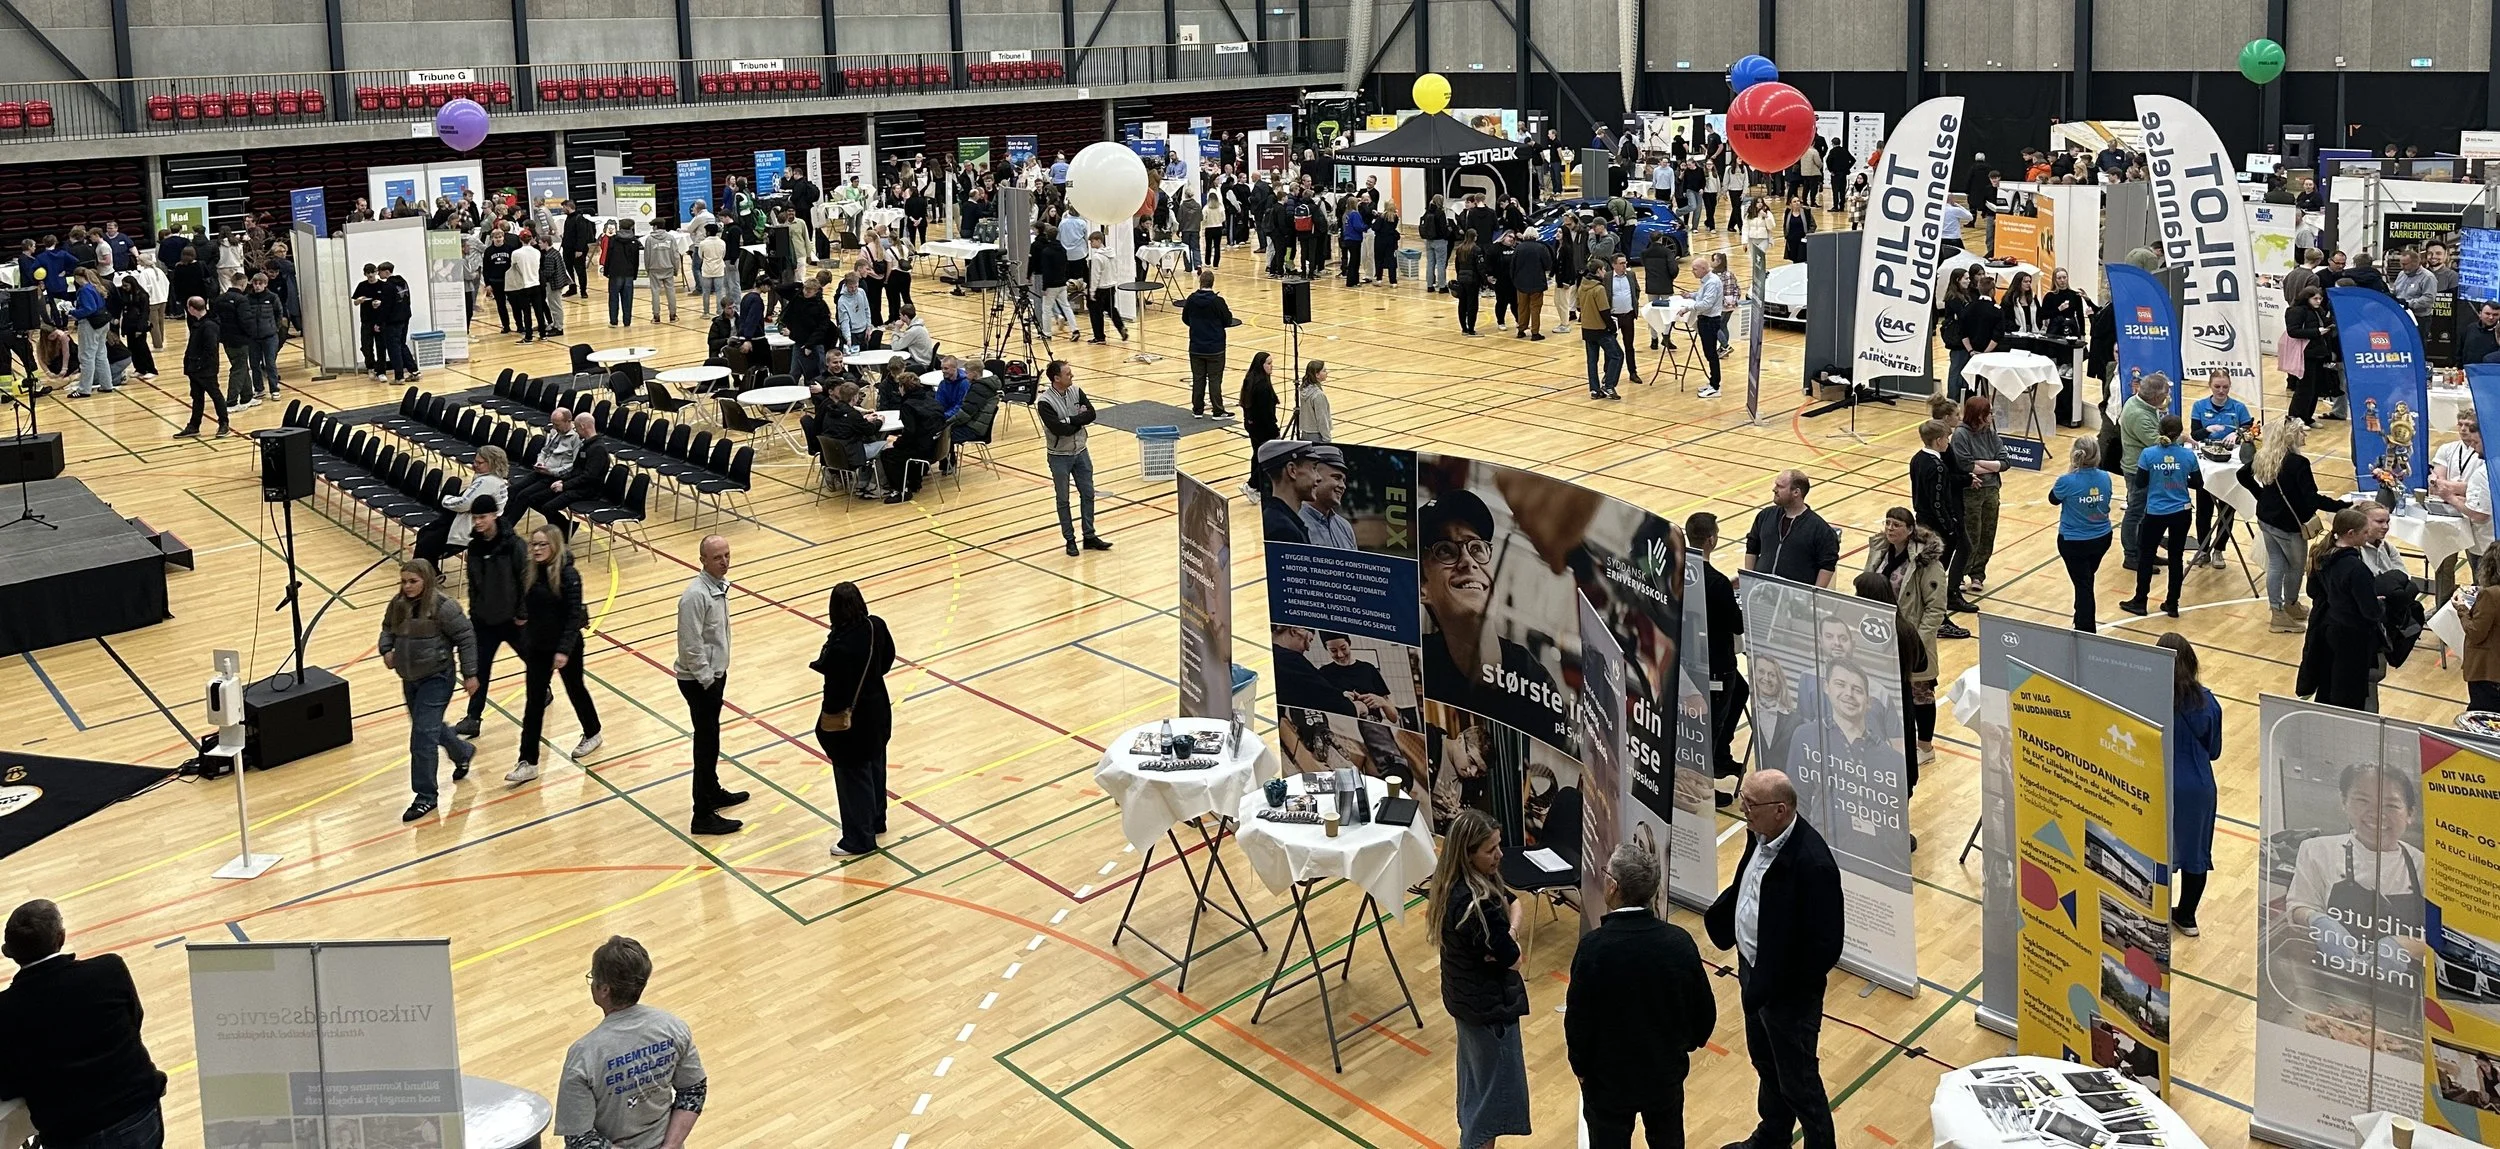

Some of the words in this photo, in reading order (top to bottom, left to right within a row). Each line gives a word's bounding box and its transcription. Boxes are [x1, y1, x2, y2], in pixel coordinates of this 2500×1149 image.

[418, 73, 455, 81] Tribune
[458, 71, 466, 80] G
[739, 62, 769, 70] Tribune
[1335, 154, 1356, 162] MAKE
[1358, 155, 1378, 163] YOUR
[1397, 156, 1442, 164] DIFFERENT
[170, 212, 189, 222] Mad
[1908, 113, 1958, 305] Uddannelse
[1872, 153, 1919, 298] PILOT
[2389, 221, 2400, 230] EN
[2400, 222, 2456, 231] FREMTIDSSIKRET
[2264, 302, 2279, 310] Town
[1882, 317, 1916, 334] BAC
[1858, 350, 1917, 373] AIRCENTER
[1869, 346, 1909, 361] BILLUND
[2153, 462, 2181, 470] HOME
[2078, 494, 2104, 504] HOME
[1385, 486, 1408, 549] EUX
[1285, 554, 1312, 563] BYGGERI,
[1312, 556, 1335, 565] ENERGI
[1345, 560, 1391, 574] KONSTRUKTION
[1286, 564, 1310, 574] MOTOR,
[1310, 567, 1345, 578] TRANSPORT
[1355, 573, 1389, 584] TEKNOLOGI
[1606, 556, 1647, 582] SYDDANSK
[1286, 576, 1308, 586] ROBOT,
[1309, 579, 1342, 590] TEKNOLOGI
[1342, 583, 1351, 591] OG
[1352, 585, 1387, 596] AUTOMATIK
[1295, 588, 1324, 598] NETVÆRK
[1334, 593, 1356, 603] DESIGN
[1606, 568, 1668, 605] ERHVERVSSKOLE
[1288, 598, 1326, 610] MENNESKER,
[1327, 603, 1352, 613] LIVSSTIL
[1352, 607, 1361, 615] OG
[1362, 608, 1390, 620] SUNDHED
[1288, 609, 1330, 621] GASTRONOMI,
[1330, 615, 1362, 626] ERNÆRING
[1373, 622, 1397, 632] SERVICE
[1482, 662, 1564, 714] største
[1633, 698, 1662, 738] din
[2020, 691, 2031, 700] DIT
[2032, 693, 2051, 704] VALG
[2013, 703, 2025, 713] DIN
[2025, 705, 2072, 720] UDDANNELSE
[1554, 722, 1566, 736] på
[2018, 727, 2151, 804] TRANSPORTUDDANNELSER
[2022, 756, 2040, 769] inden
[2041, 764, 2052, 776] for
[2053, 770, 2082, 791] følgende
[2022, 746, 2031, 756] På
[2032, 752, 2045, 762] EUC
[2045, 758, 2074, 776] Lillebælt
[2074, 771, 2088, 784] kan
[2090, 779, 2100, 790] du
[2101, 785, 2130, 807] uddanne
[2130, 800, 2143, 816] dig
[2441, 769, 2456, 780] DIT
[2458, 772, 2486, 784] VALG
[2428, 781, 2446, 793] DIN
[2019, 773, 2113, 828] Vejgodstransportuddannelser
[2435, 818, 2475, 840] LAGER-
[2477, 835, 2496, 848] OG
[2435, 839, 2447, 850] På
[2448, 844, 2466, 858] EUC
[2021, 849, 2062, 874] uddannelsen
[2435, 868, 2491, 897] Lageroperatør
[2435, 877, 2491, 907] Lageroperatør
[2461, 900, 2472, 912] og
[2023, 945, 2064, 973] uddannelsen
[2023, 988, 2065, 1020] Overbygning
[2072, 1021, 2085, 1035] alle
[607, 1038, 674, 1070] FREMTIDEN
[605, 1072, 624, 1086] ER
[627, 1052, 676, 1078] FAGLÆRT
[614, 1081, 638, 1095] Skal
[639, 1076, 652, 1086] DU
